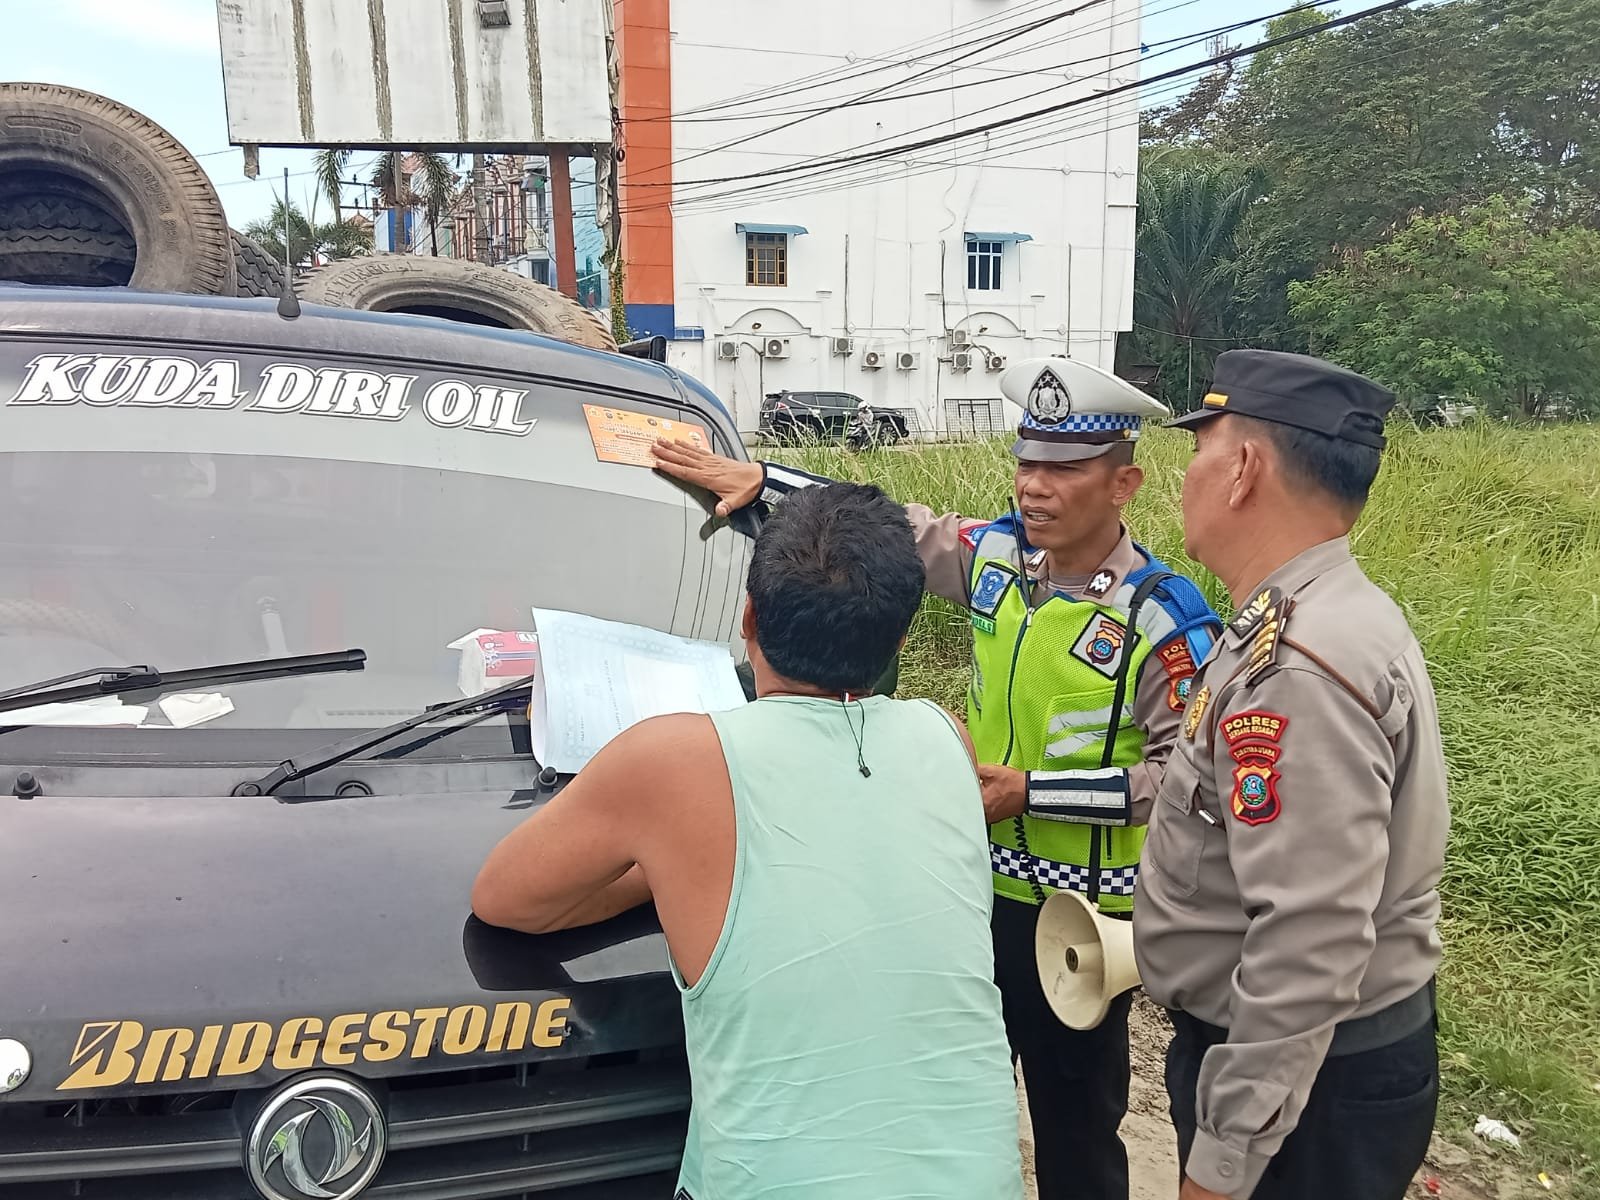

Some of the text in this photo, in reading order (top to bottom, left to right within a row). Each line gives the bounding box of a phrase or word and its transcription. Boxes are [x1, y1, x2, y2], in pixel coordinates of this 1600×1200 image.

[6, 354, 537, 437] KUDA DIRI OIL
[1224, 716, 1280, 733] POLRES
[56, 998, 572, 1090] BRIDGESTONE
